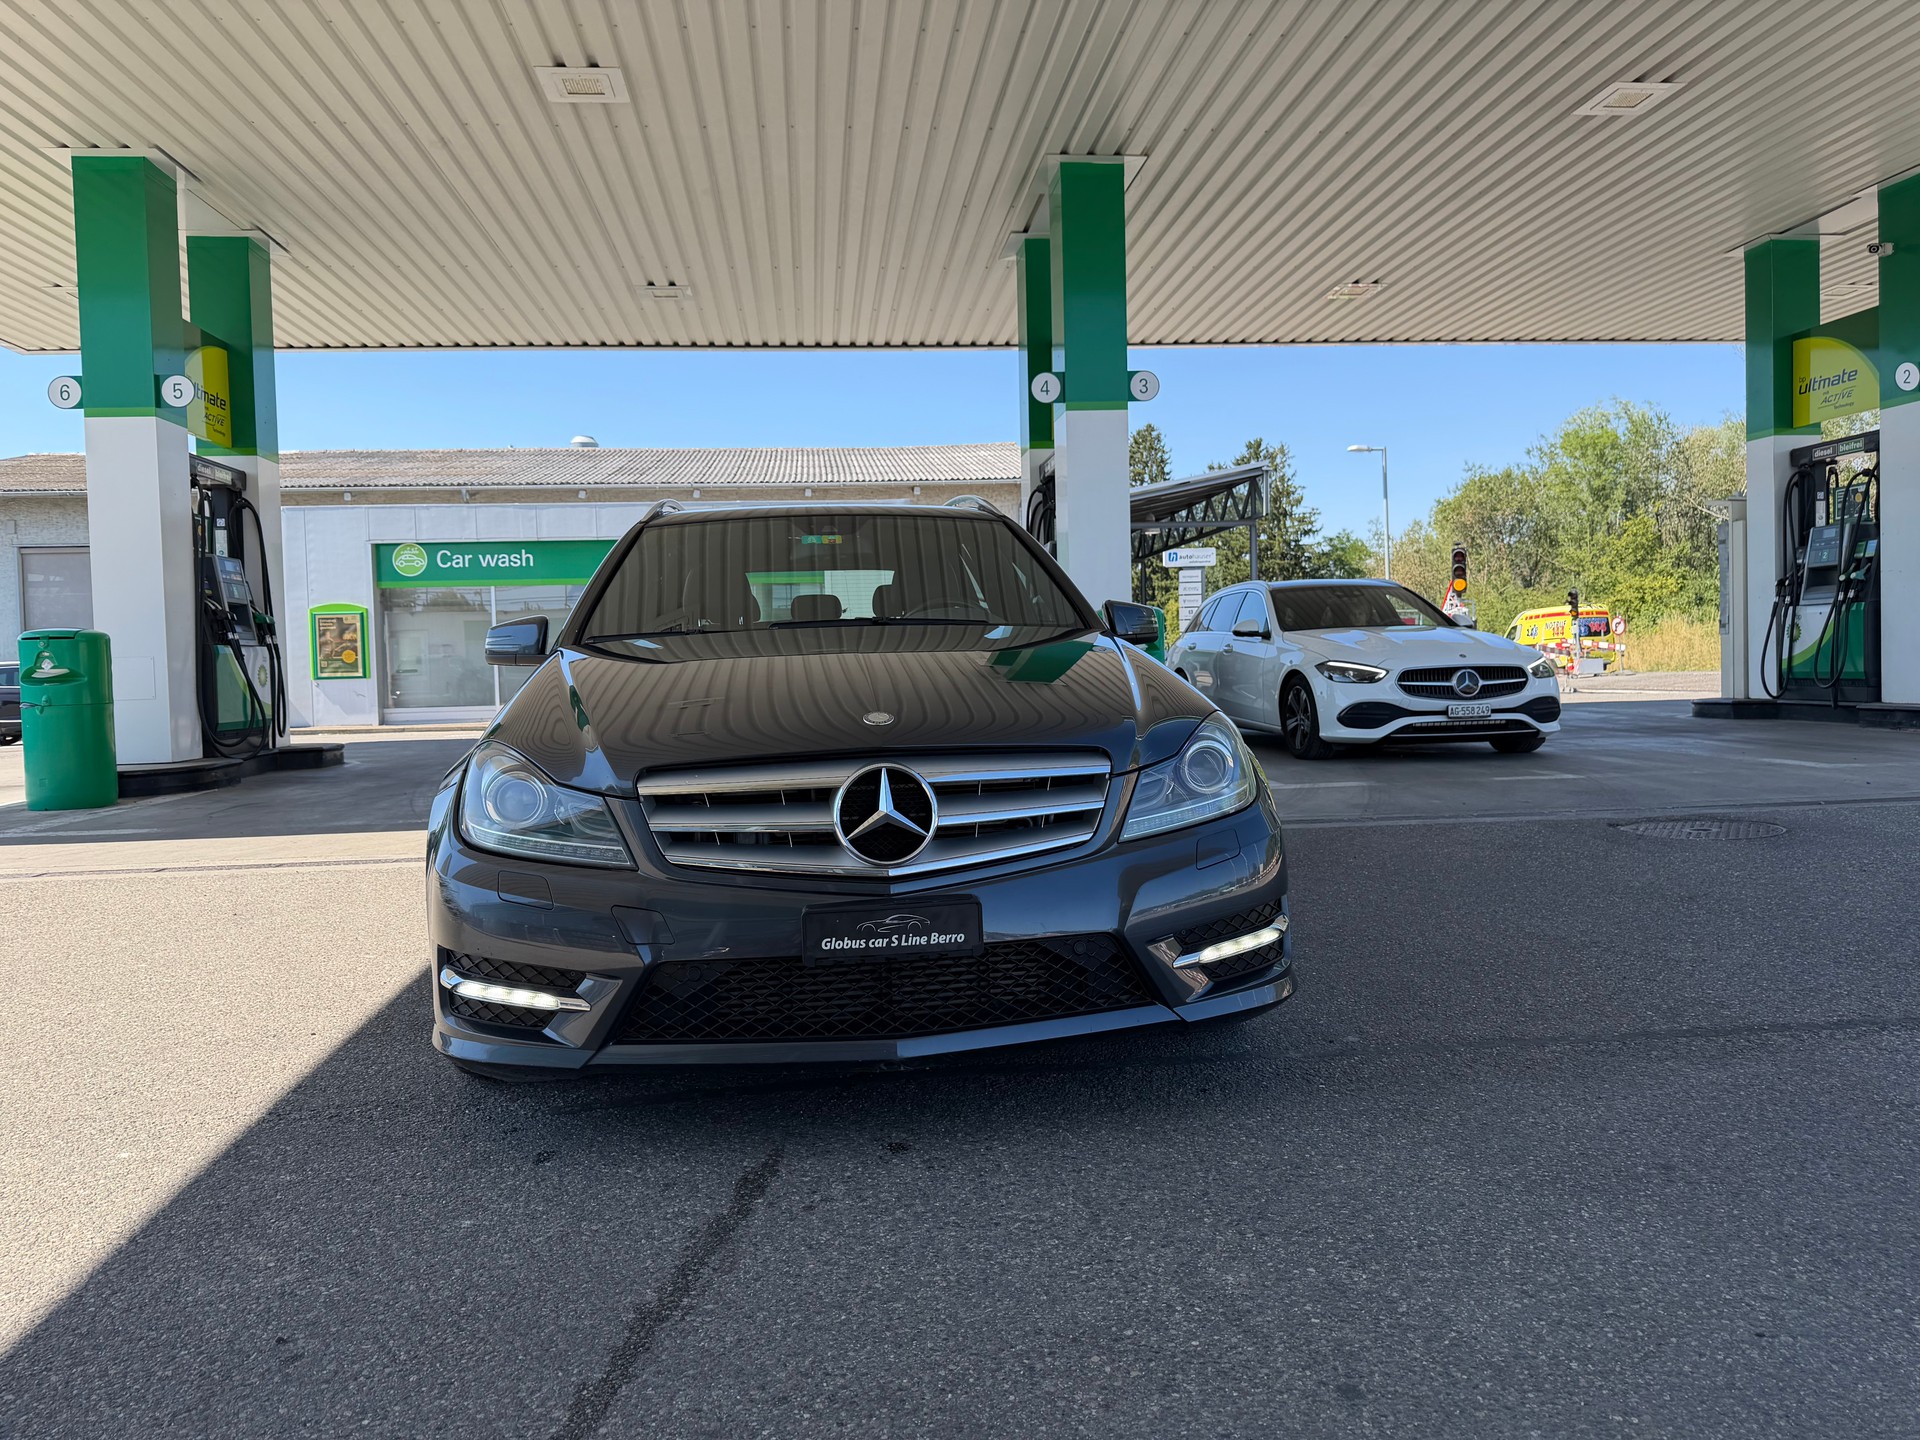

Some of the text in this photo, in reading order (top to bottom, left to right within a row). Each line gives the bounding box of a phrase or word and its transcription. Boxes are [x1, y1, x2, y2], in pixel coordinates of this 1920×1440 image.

[1798, 368, 1858, 395] ultimate
[1903, 369, 1911, 384] 2
[59, 384, 70, 401] 6
[172, 383, 183, 399] 5
[1040, 380, 1050, 396] 4
[1139, 378, 1149, 394] 3
[194, 381, 226, 411] ltimate
[1821, 389, 1854, 405] ACTIVE
[1814, 447, 1833, 458] diesel
[1839, 440, 1863, 452] bleifrei
[436, 549, 534, 568] Car wash
[821, 932, 965, 950] Globus car S Line Berro
